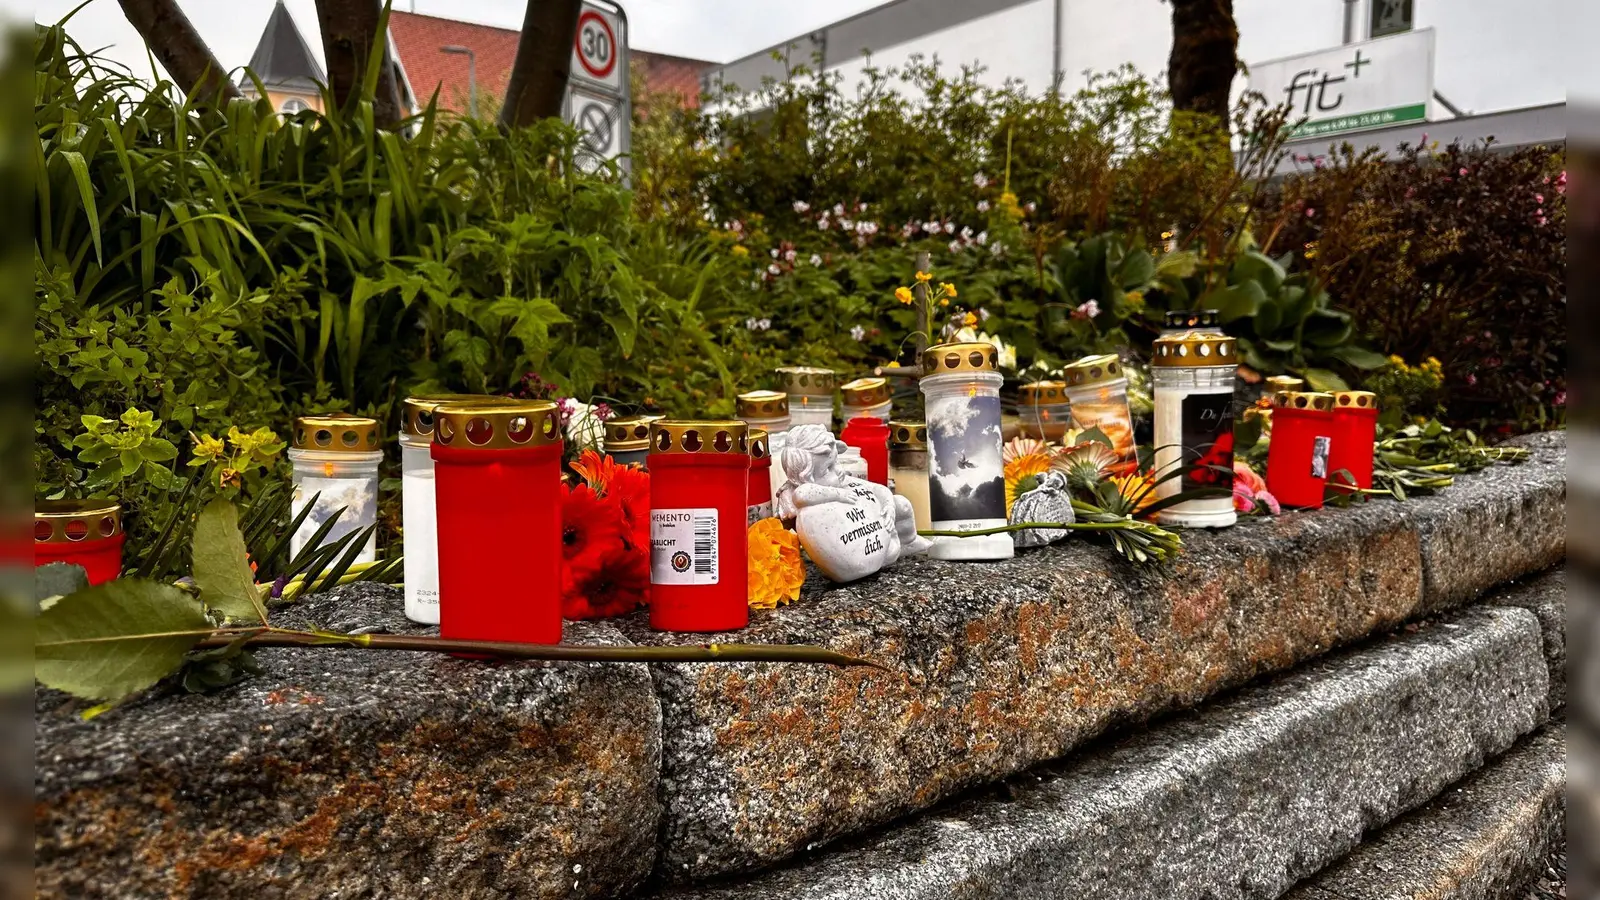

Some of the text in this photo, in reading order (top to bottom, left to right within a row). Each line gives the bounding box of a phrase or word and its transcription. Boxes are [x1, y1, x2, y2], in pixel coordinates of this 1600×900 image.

[583, 27, 608, 62] 30
[651, 513, 691, 522] MEMENTO
[845, 507, 866, 523] Wir
[840, 520, 883, 545] vermissen
